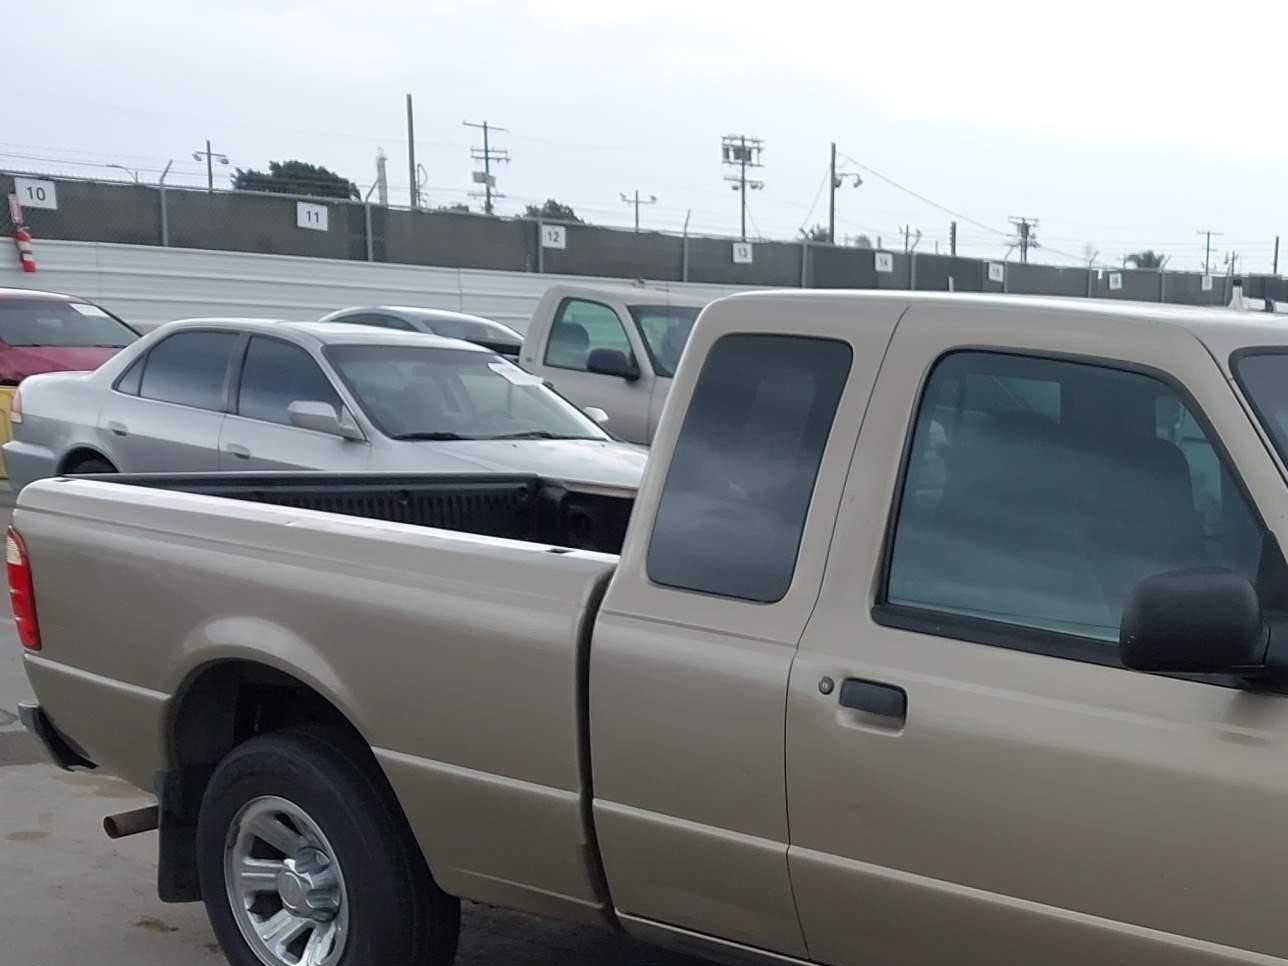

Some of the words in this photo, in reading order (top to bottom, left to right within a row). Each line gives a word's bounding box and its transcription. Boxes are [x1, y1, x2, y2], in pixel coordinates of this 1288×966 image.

[26, 186, 46, 201] 10
[306, 210, 320, 224] 11
[547, 231, 560, 243] 12
